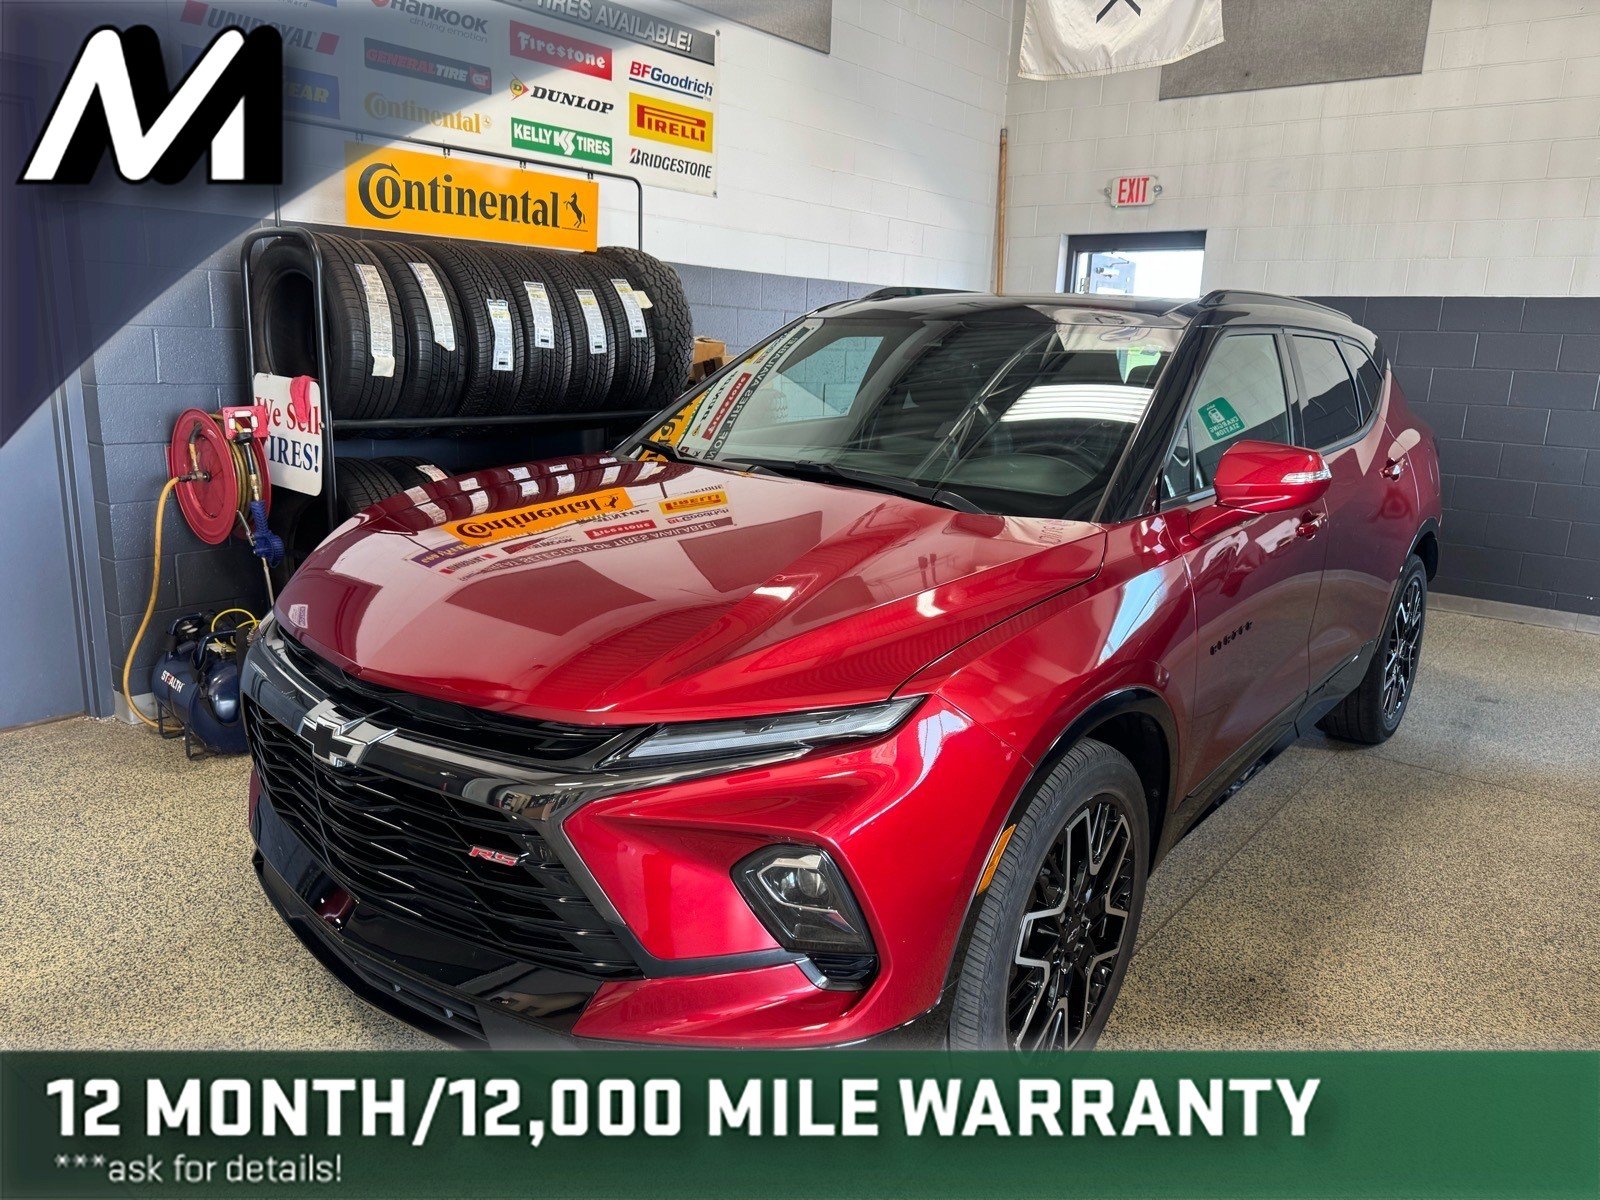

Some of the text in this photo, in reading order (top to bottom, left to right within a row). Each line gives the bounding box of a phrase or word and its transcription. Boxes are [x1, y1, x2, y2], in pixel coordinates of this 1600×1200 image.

[207, 8, 315, 50] UNIYAL
[409, 16, 488, 43] driving emotion
[595, 5, 693, 52] AVAILABLE!
[517, 31, 606, 69] Firestone
[629, 60, 714, 96] BFGoodrich
[363, 91, 482, 134] Continental
[530, 86, 615, 114] DUNLOP
[513, 122, 552, 145] KELLY
[576, 135, 611, 157] TIRES
[636, 103, 707, 143] PIRELLI
[629, 148, 713, 179] BRIDGESTONE
[358, 162, 561, 229] Continental
[1117, 177, 1150, 204] EXIT
[265, 433, 319, 473] IRES!
[468, 845, 520, 867] RS
